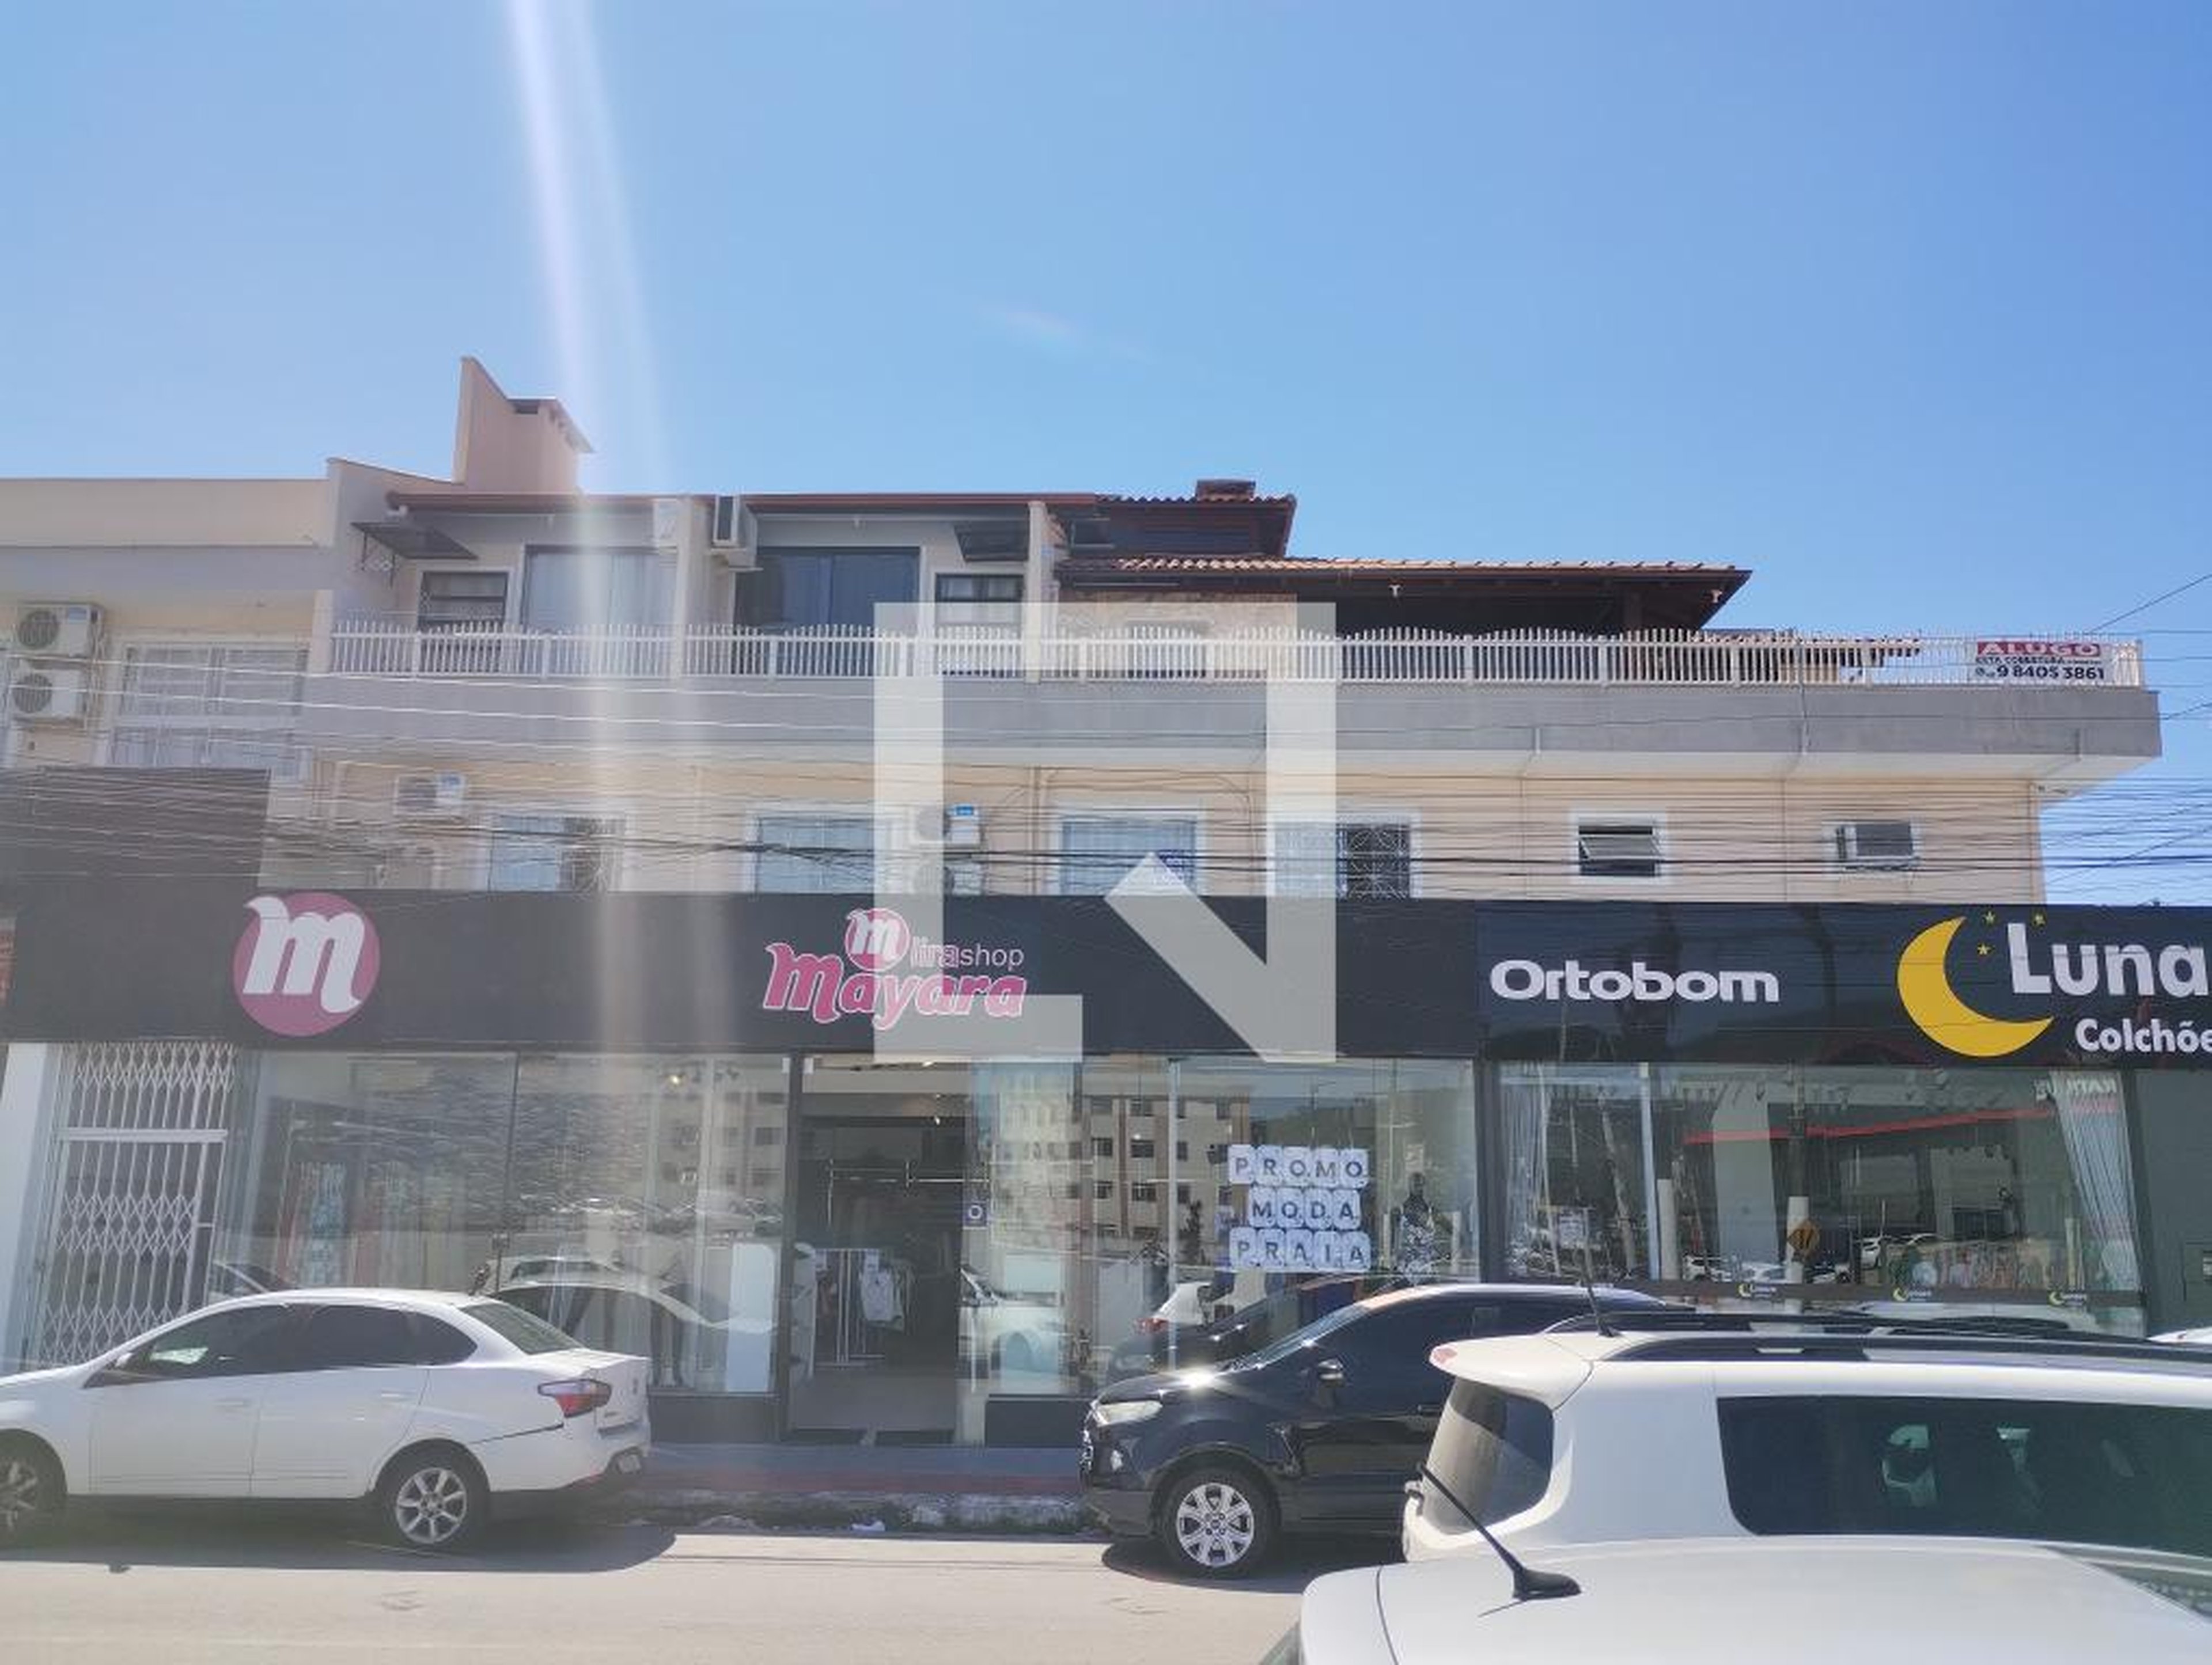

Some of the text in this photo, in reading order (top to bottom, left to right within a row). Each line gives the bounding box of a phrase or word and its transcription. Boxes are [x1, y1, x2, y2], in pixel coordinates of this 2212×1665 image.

[1981, 643, 2099, 657] ALUGO
[1997, 665, 2009, 678] 9
[2063, 667, 2104, 680] 3861
[2008, 923, 2209, 998] Luna
[1490, 959, 1780, 1003] Ortobom
[1236, 1157, 1363, 1179] PROMO
[1252, 1201, 1354, 1220] MODA
[1237, 1241, 1365, 1262] PRAIA
